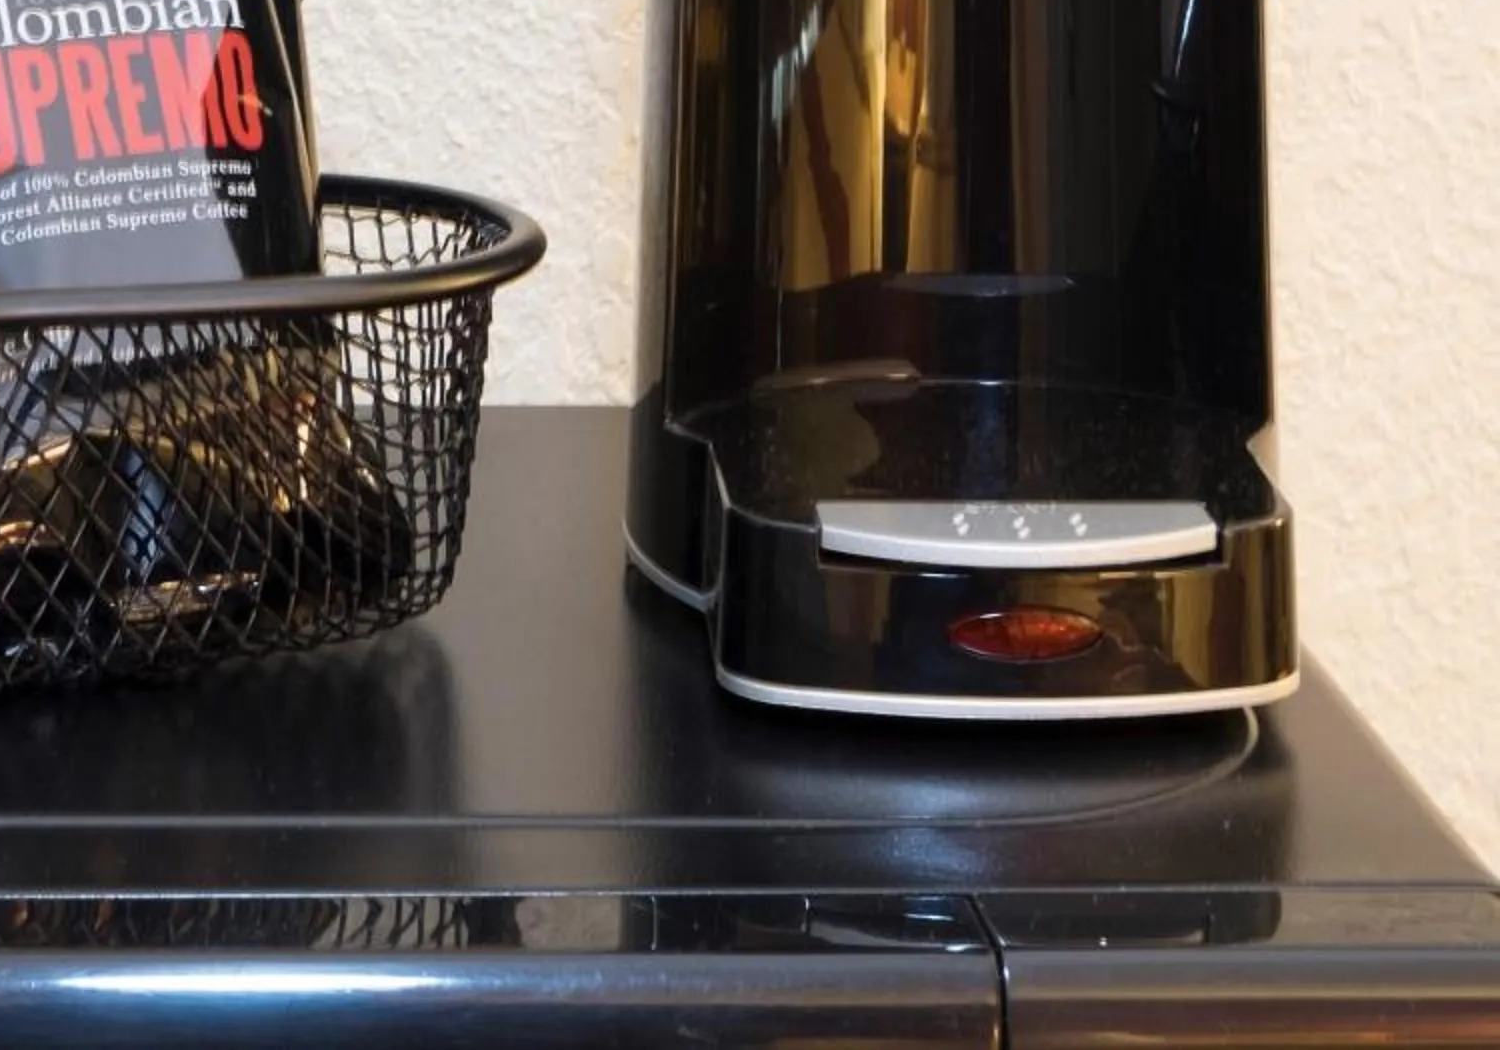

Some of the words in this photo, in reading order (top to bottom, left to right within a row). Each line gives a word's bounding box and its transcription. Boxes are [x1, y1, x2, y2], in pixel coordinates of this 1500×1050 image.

[0, 179, 18, 201] of
[23, 171, 70, 196] 100%
[74, 162, 174, 188] Colombian
[177, 158, 252, 179] Supremo
[46, 192, 123, 215] Alliance
[227, 180, 258, 199] and
[0, 219, 102, 247] Colombian
[106, 208, 188, 232] Supremo
[191, 201, 250, 221] Coffee
